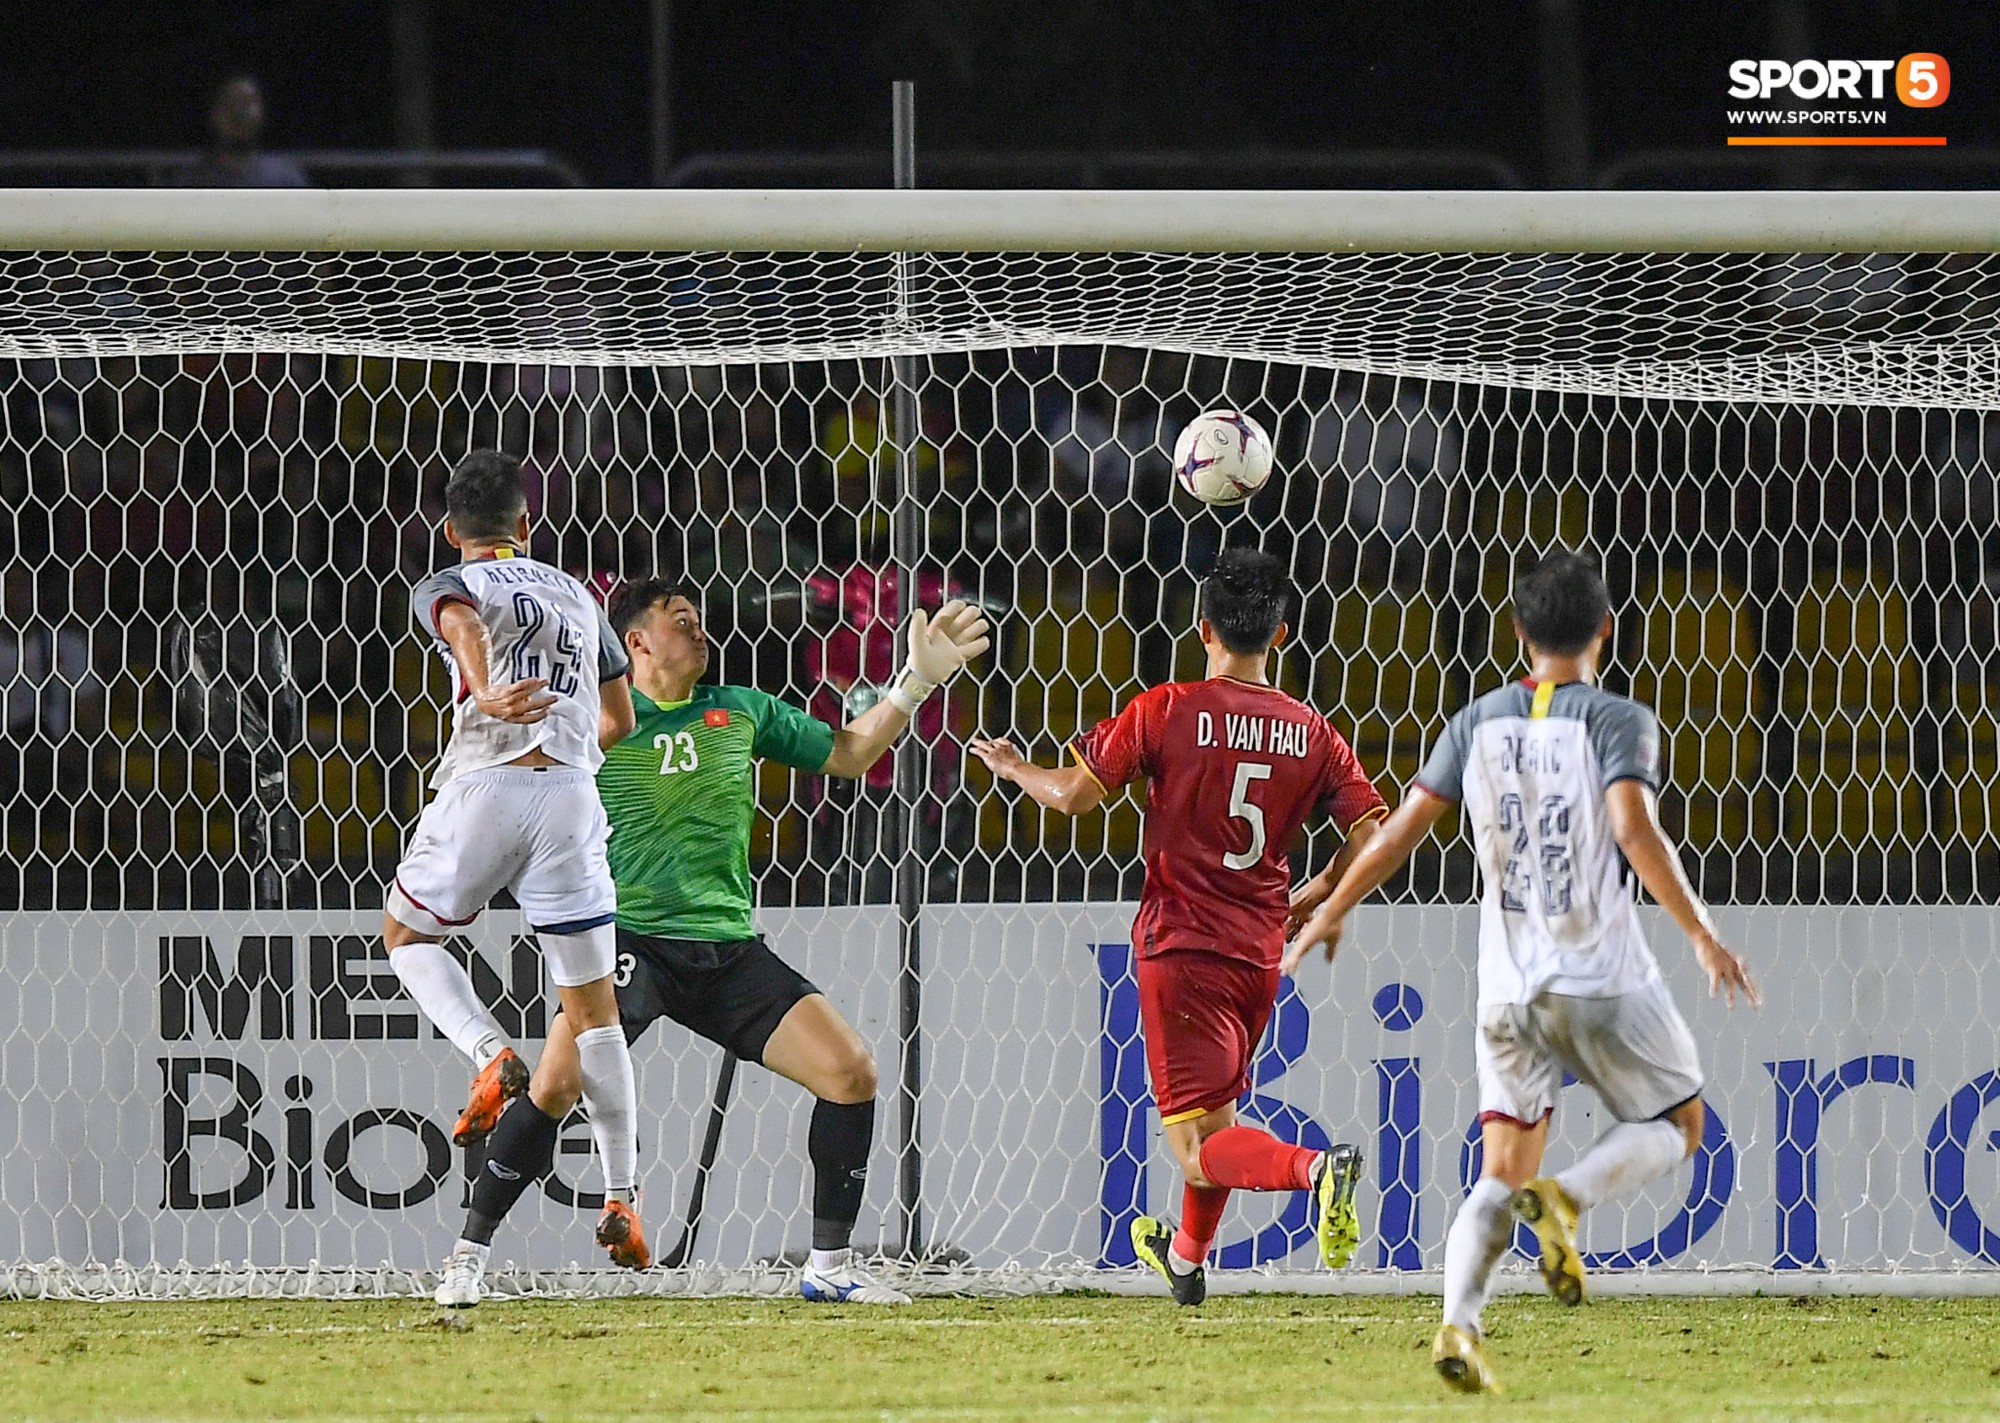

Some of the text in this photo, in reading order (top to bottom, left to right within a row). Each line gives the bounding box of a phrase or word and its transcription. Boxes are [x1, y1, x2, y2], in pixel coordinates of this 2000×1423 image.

[653, 732, 698, 774] 23
[1197, 711, 1308, 758] D. VAN HAU
[1222, 762, 1272, 871] 5
